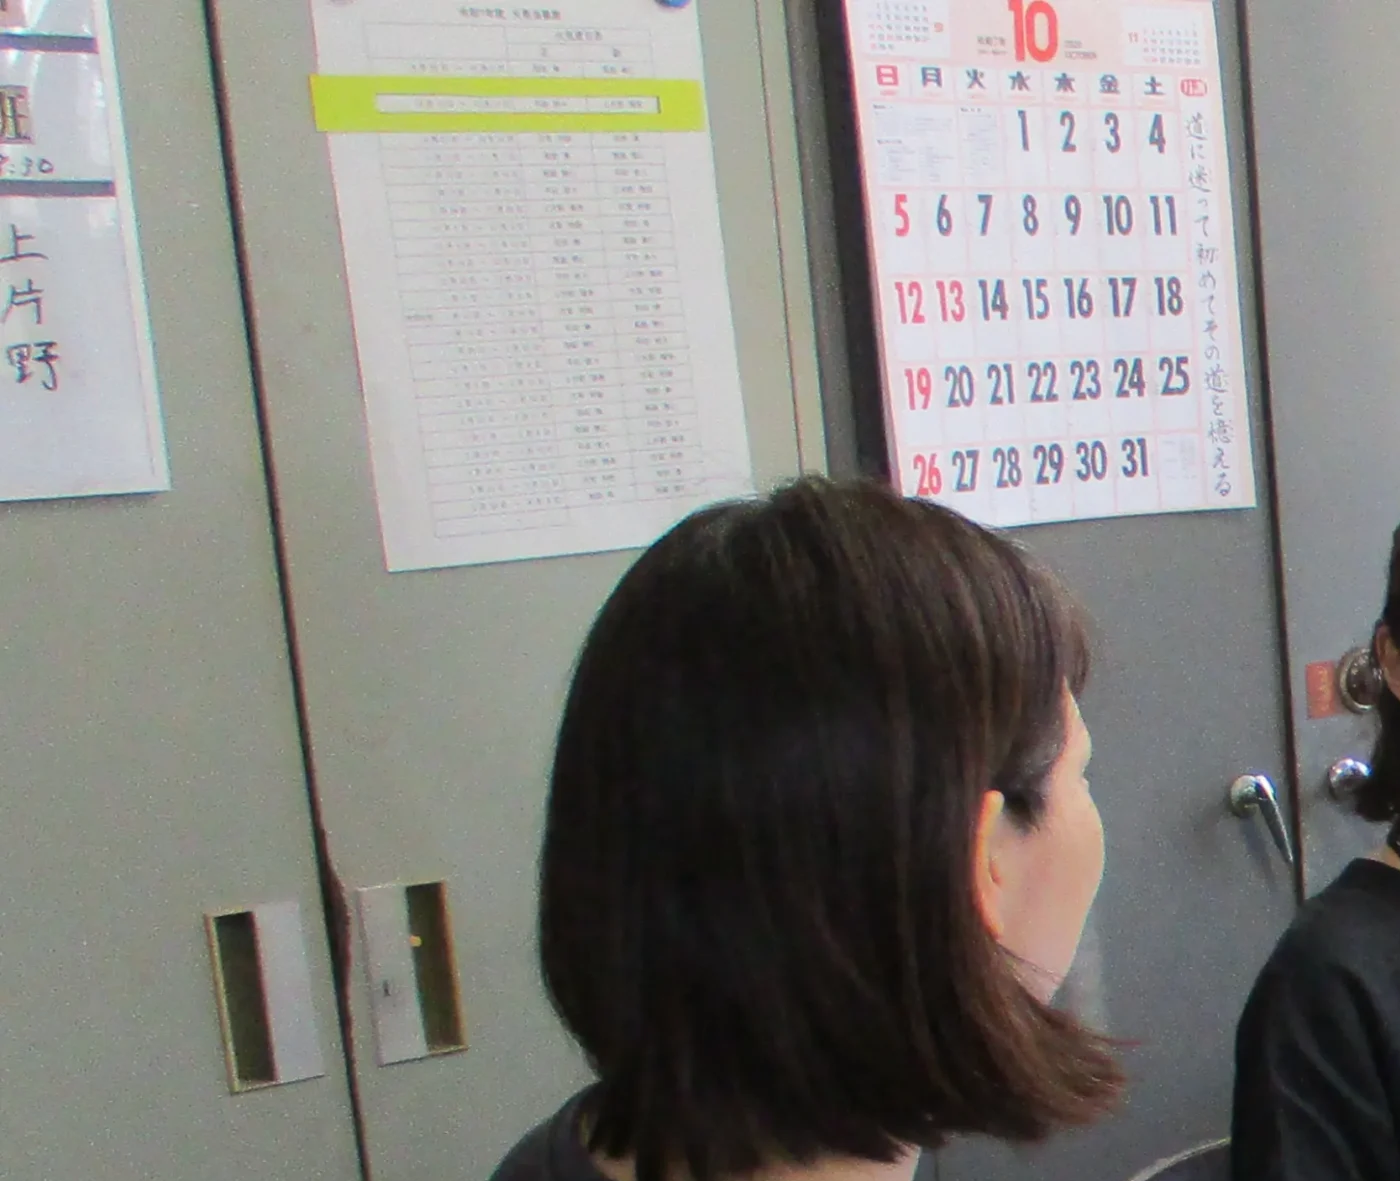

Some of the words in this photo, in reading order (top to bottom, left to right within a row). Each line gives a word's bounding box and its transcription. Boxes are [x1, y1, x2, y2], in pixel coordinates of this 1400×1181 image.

[1007, 0, 1058, 62] 10
[876, 65, 899, 86] 日
[921, 66, 942, 88] 月
[966, 69, 986, 90] 火
[1008, 71, 1031, 91] 水
[1054, 72, 1076, 93] 木
[1099, 74, 1121, 94] 金
[1144, 76, 1166, 95] 土
[1018, 111, 1028, 150] 1
[1061, 112, 1075, 152] 2
[1105, 113, 1120, 152] 3
[1150, 115, 1165, 153] 4
[895, 194, 909, 236] 5
[938, 195, 952, 236] 6
[979, 195, 992, 234] 7
[1024, 195, 1038, 235] 8
[1065, 196, 1081, 235] 9
[1104, 196, 1132, 235] 10
[1151, 196, 1176, 235] 11
[895, 282, 924, 323] 12
[937, 281, 964, 321] 13
[979, 280, 1008, 320] 14
[1023, 279, 1049, 319] 15
[1065, 279, 1093, 318] 16
[1109, 278, 1136, 317] 17
[1155, 277, 1183, 315] 18
[906, 368, 931, 409] 19
[945, 366, 973, 407] 20
[988, 364, 1014, 404] 21
[1028, 362, 1058, 402] 22
[1071, 360, 1101, 400] 23
[1114, 359, 1145, 397] 24
[1159, 357, 1189, 395] 25
[913, 453, 941, 495] 26
[953, 450, 978, 492] 27
[994, 448, 1021, 488] 28
[1034, 444, 1063, 484] 29
[1076, 441, 1107, 481] 30
[1122, 438, 1148, 477] 31
